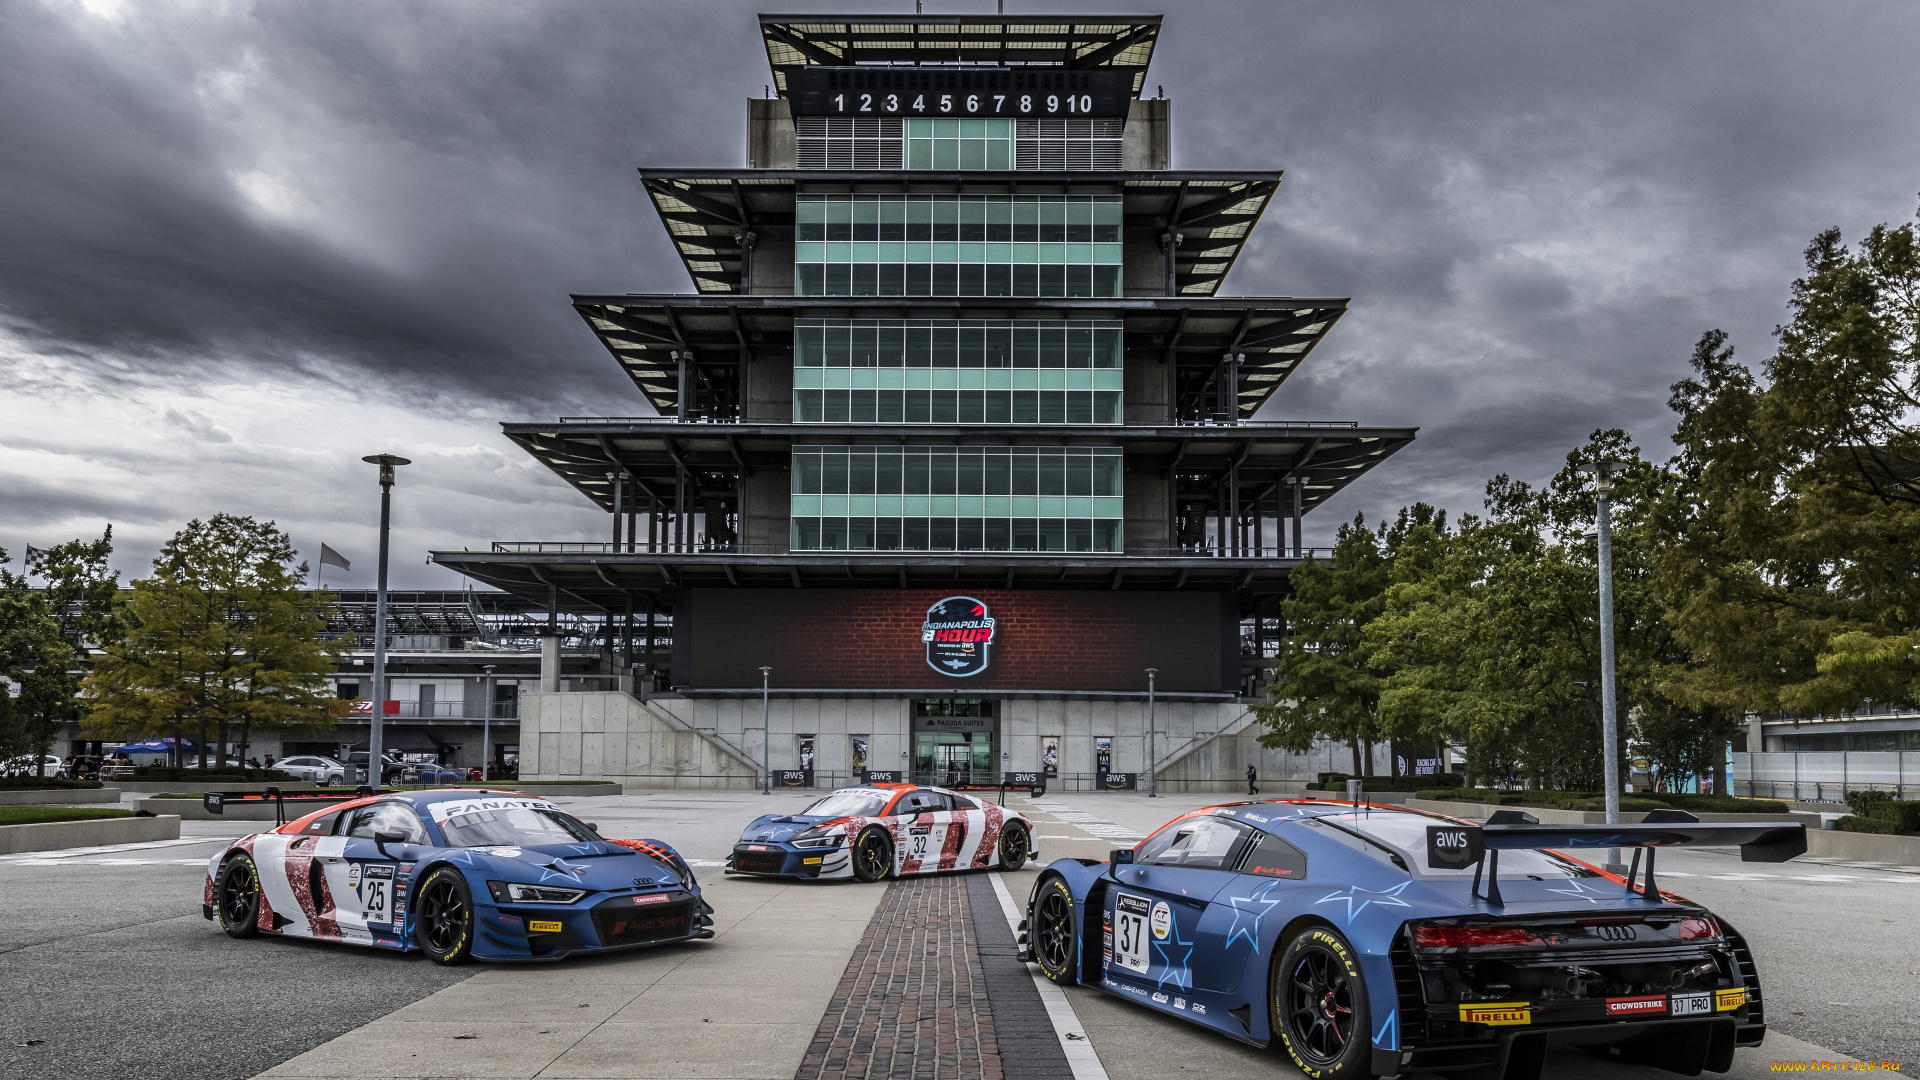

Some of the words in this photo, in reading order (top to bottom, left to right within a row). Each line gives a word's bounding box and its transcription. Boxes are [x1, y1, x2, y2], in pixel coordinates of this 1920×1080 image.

[835, 94, 843, 111] 1
[860, 94, 871, 111] 2
[887, 95, 898, 111] 3
[913, 95, 924, 111] 4
[941, 95, 951, 112] 5
[967, 95, 978, 112] 6
[994, 96, 1005, 112] 7
[1021, 95, 1031, 112] 8
[1047, 95, 1058, 112] 9
[1067, 95, 1091, 112] 10
[923, 620, 992, 629] INDIANAPOLIS
[935, 628, 991, 642] HOUR
[783, 771, 804, 780] aws
[870, 771, 892, 780] aws
[1015, 773, 1037, 782] aws
[1106, 774, 1126, 783] aws
[208, 796, 220, 805] aws
[914, 836, 926, 854] 32
[1436, 831, 1467, 848] aws
[759, 860, 777, 868] Sport
[1260, 866, 1274, 874] Audi
[1274, 867, 1292, 876] Sport
[367, 881, 385, 912] 25
[1054, 881, 1073, 907] PIRELLI
[1123, 898, 1148, 909] REBELLION
[532, 922, 560, 930] PIRELLI
[629, 919, 655, 931] Audi
[657, 915, 685, 928] Sport
[1120, 915, 1142, 955] 37
[1312, 931, 1357, 977] PIRELLI
[1130, 957, 1141, 968] PRO
[1611, 999, 1663, 1011] CROWDSTRIKE
[1673, 999, 1684, 1013] 37
[1691, 998, 1709, 1011] PRO
[1719, 993, 1744, 1007] PIRELLI
[1466, 1008, 1524, 1022] PIRELLI
[1282, 1033, 1321, 1079] PZERO
